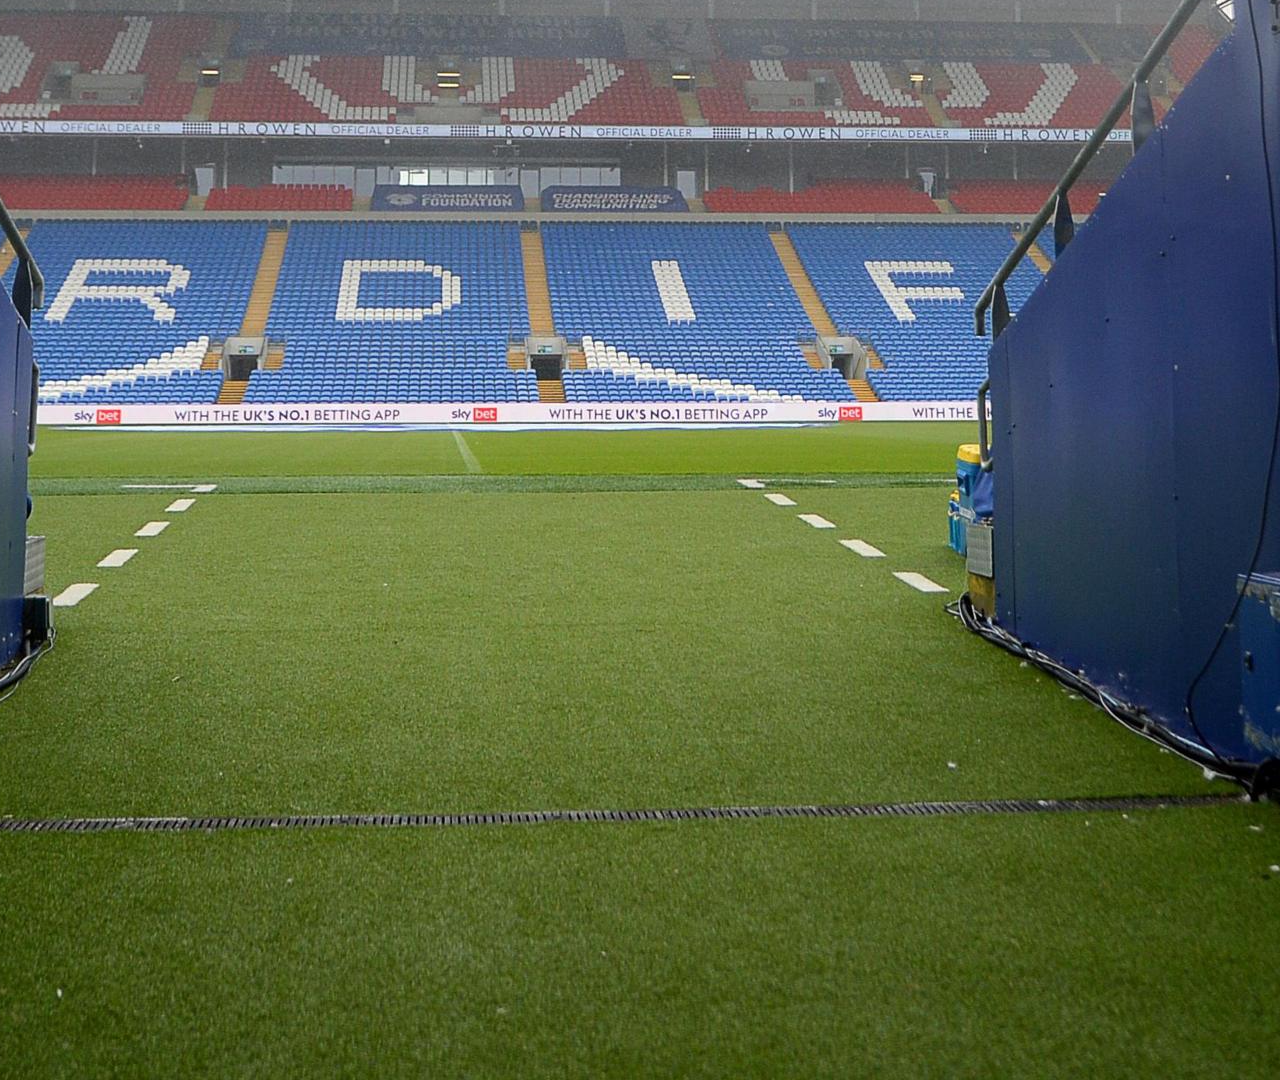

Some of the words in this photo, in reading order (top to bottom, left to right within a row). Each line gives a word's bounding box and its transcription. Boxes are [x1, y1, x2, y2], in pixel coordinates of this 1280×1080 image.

[60, 122, 112, 133] OFFICIAL
[117, 123, 161, 133] DEALER
[331, 125, 382, 135] OFFICIAL
[386, 126, 430, 135] DEALER
[596, 127, 647, 137] OFFICIAL
[650, 127, 692, 137] DEALER
[855, 129, 905, 138] OFFICIAL
[908, 129, 949, 139] DEALER
[421, 198, 513, 207] FOUNDATION
[74, 410, 94, 422] sky
[98, 410, 120, 421] bet
[174, 410, 209, 421] WITH
[212, 410, 239, 421] THE
[243, 410, 275, 421] UK'S
[278, 410, 310, 421] NO.1
[314, 410, 371, 421] BETTING
[374, 410, 401, 420] APP
[451, 408, 471, 420] sky
[475, 408, 496, 419] bet
[549, 408, 583, 420] WITH
[587, 408, 612, 420] THE
[615, 408, 646, 420] UK'S
[650, 408, 680, 420] NO.1
[684, 408, 740, 420] BETTING
[743, 408, 769, 420] APP
[818, 407, 837, 419] sky
[840, 407, 862, 418] bet
[912, 407, 946, 418] WITH
[949, 407, 973, 418] THE
